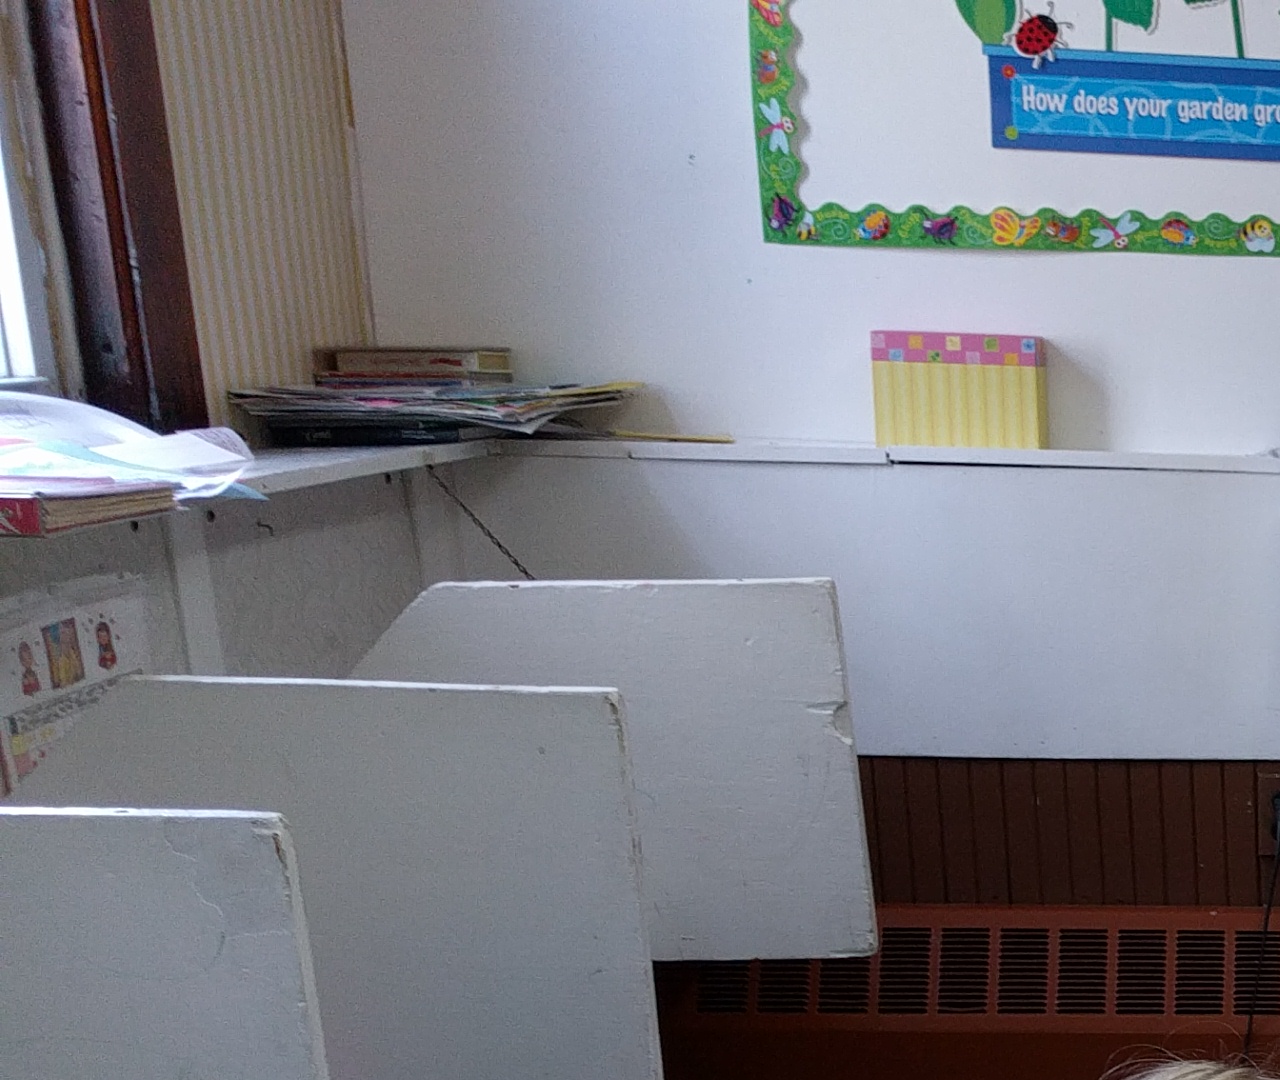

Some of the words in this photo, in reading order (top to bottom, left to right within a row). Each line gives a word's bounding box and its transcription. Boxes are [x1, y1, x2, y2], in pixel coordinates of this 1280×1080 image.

[1020, 85, 1067, 114] How
[1073, 89, 1119, 116] does
[1123, 96, 1171, 121] your
[1176, 95, 1249, 123] garden
